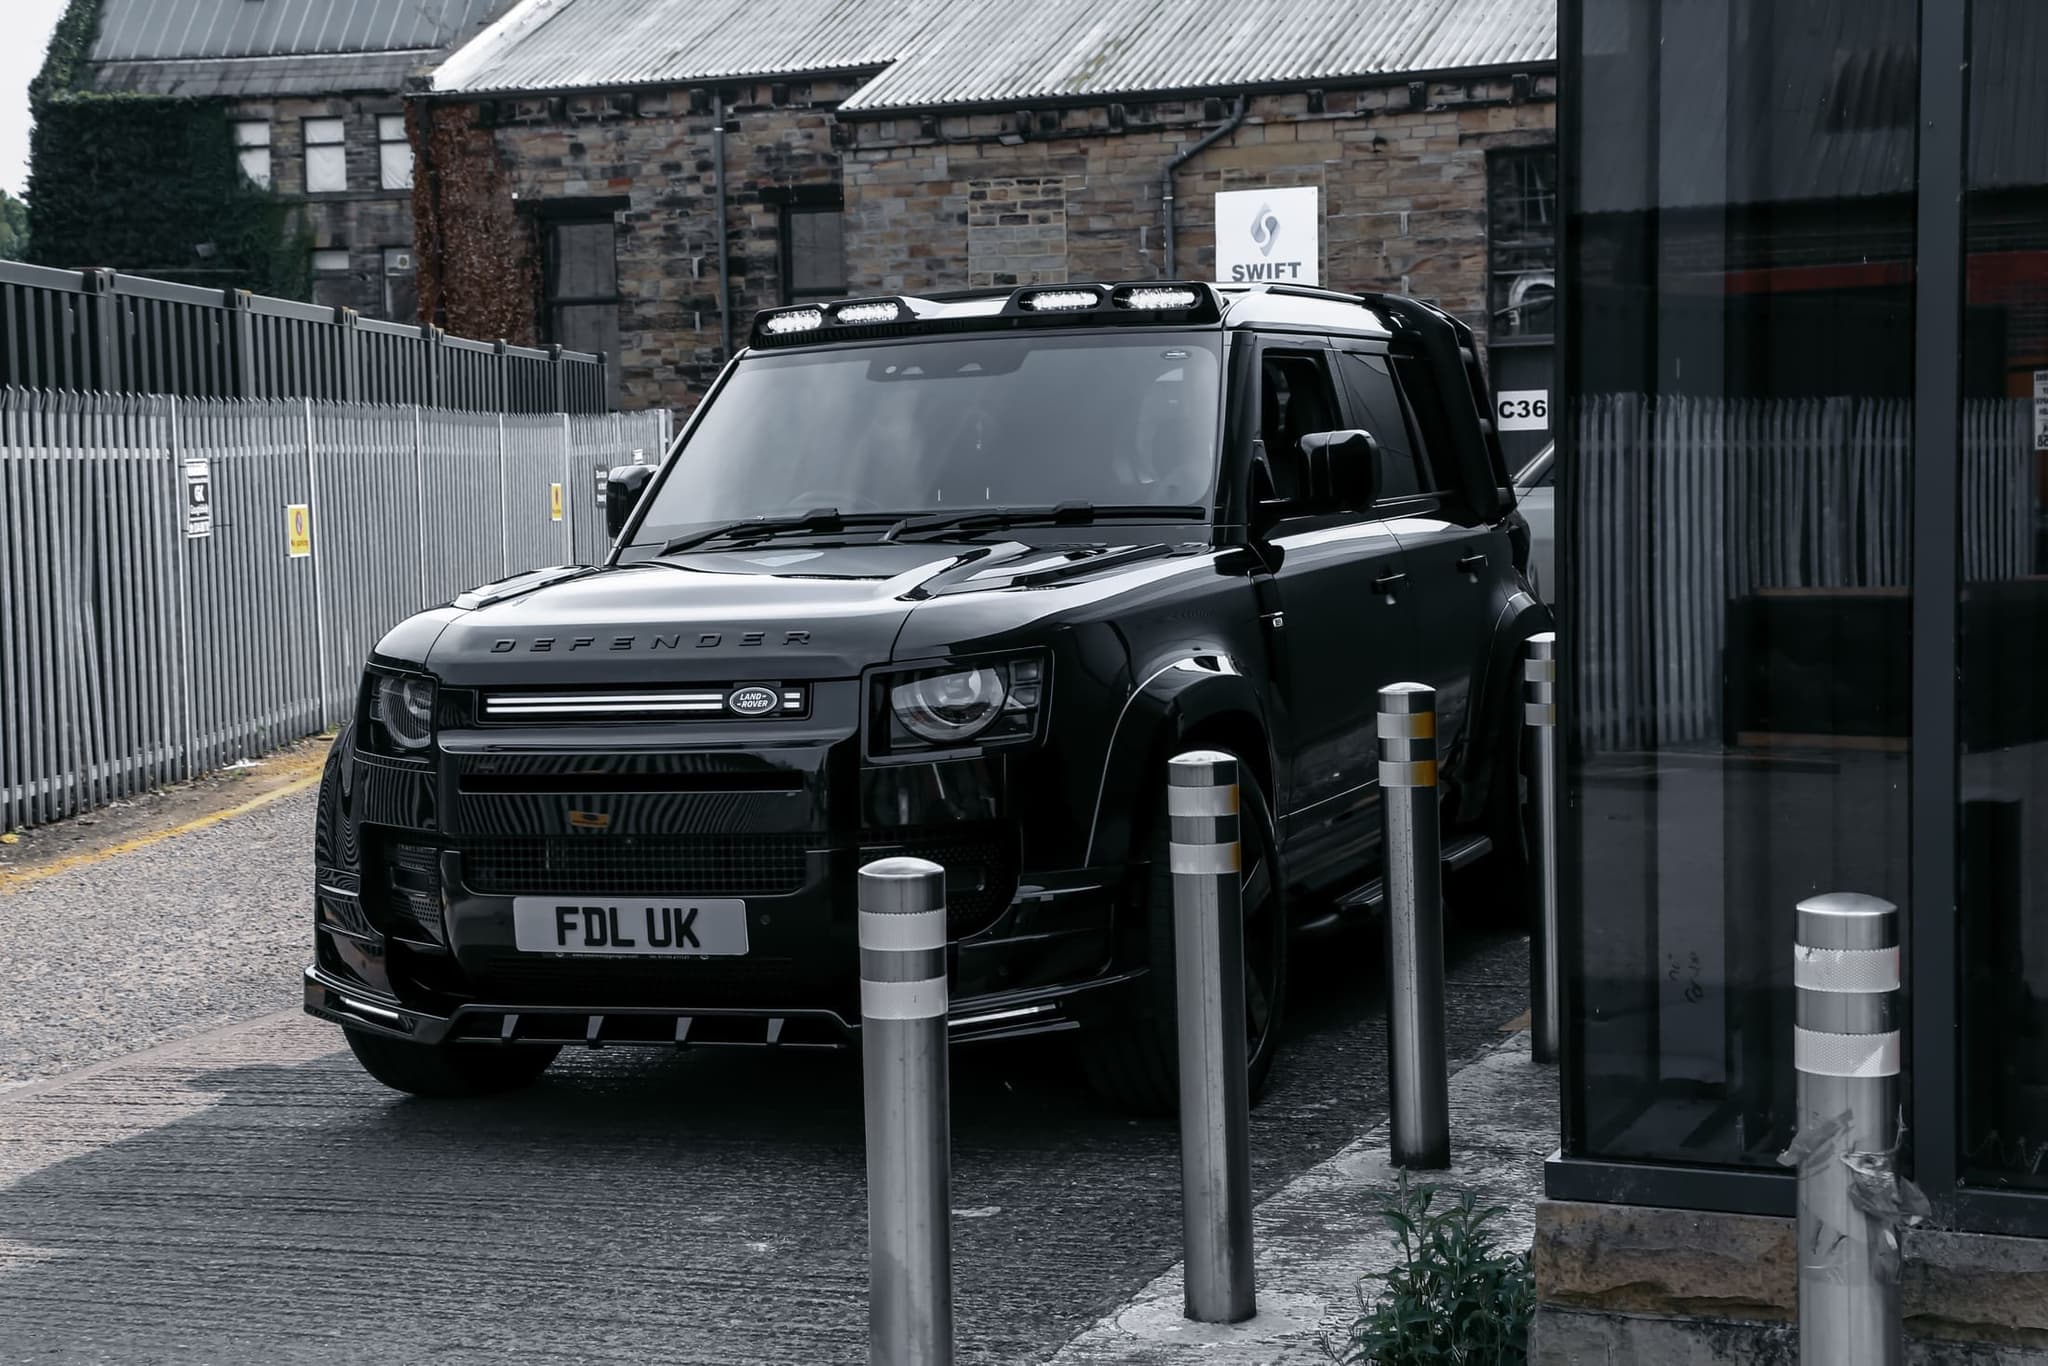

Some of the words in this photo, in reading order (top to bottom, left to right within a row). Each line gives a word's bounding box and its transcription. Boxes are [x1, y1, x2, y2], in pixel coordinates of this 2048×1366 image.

[1232, 262, 1302, 281] SWIFT
[1499, 400, 1547, 419] C36
[490, 630, 811, 653] DEFENDER
[556, 906, 635, 947] FDL
[646, 908, 700, 948] UK
